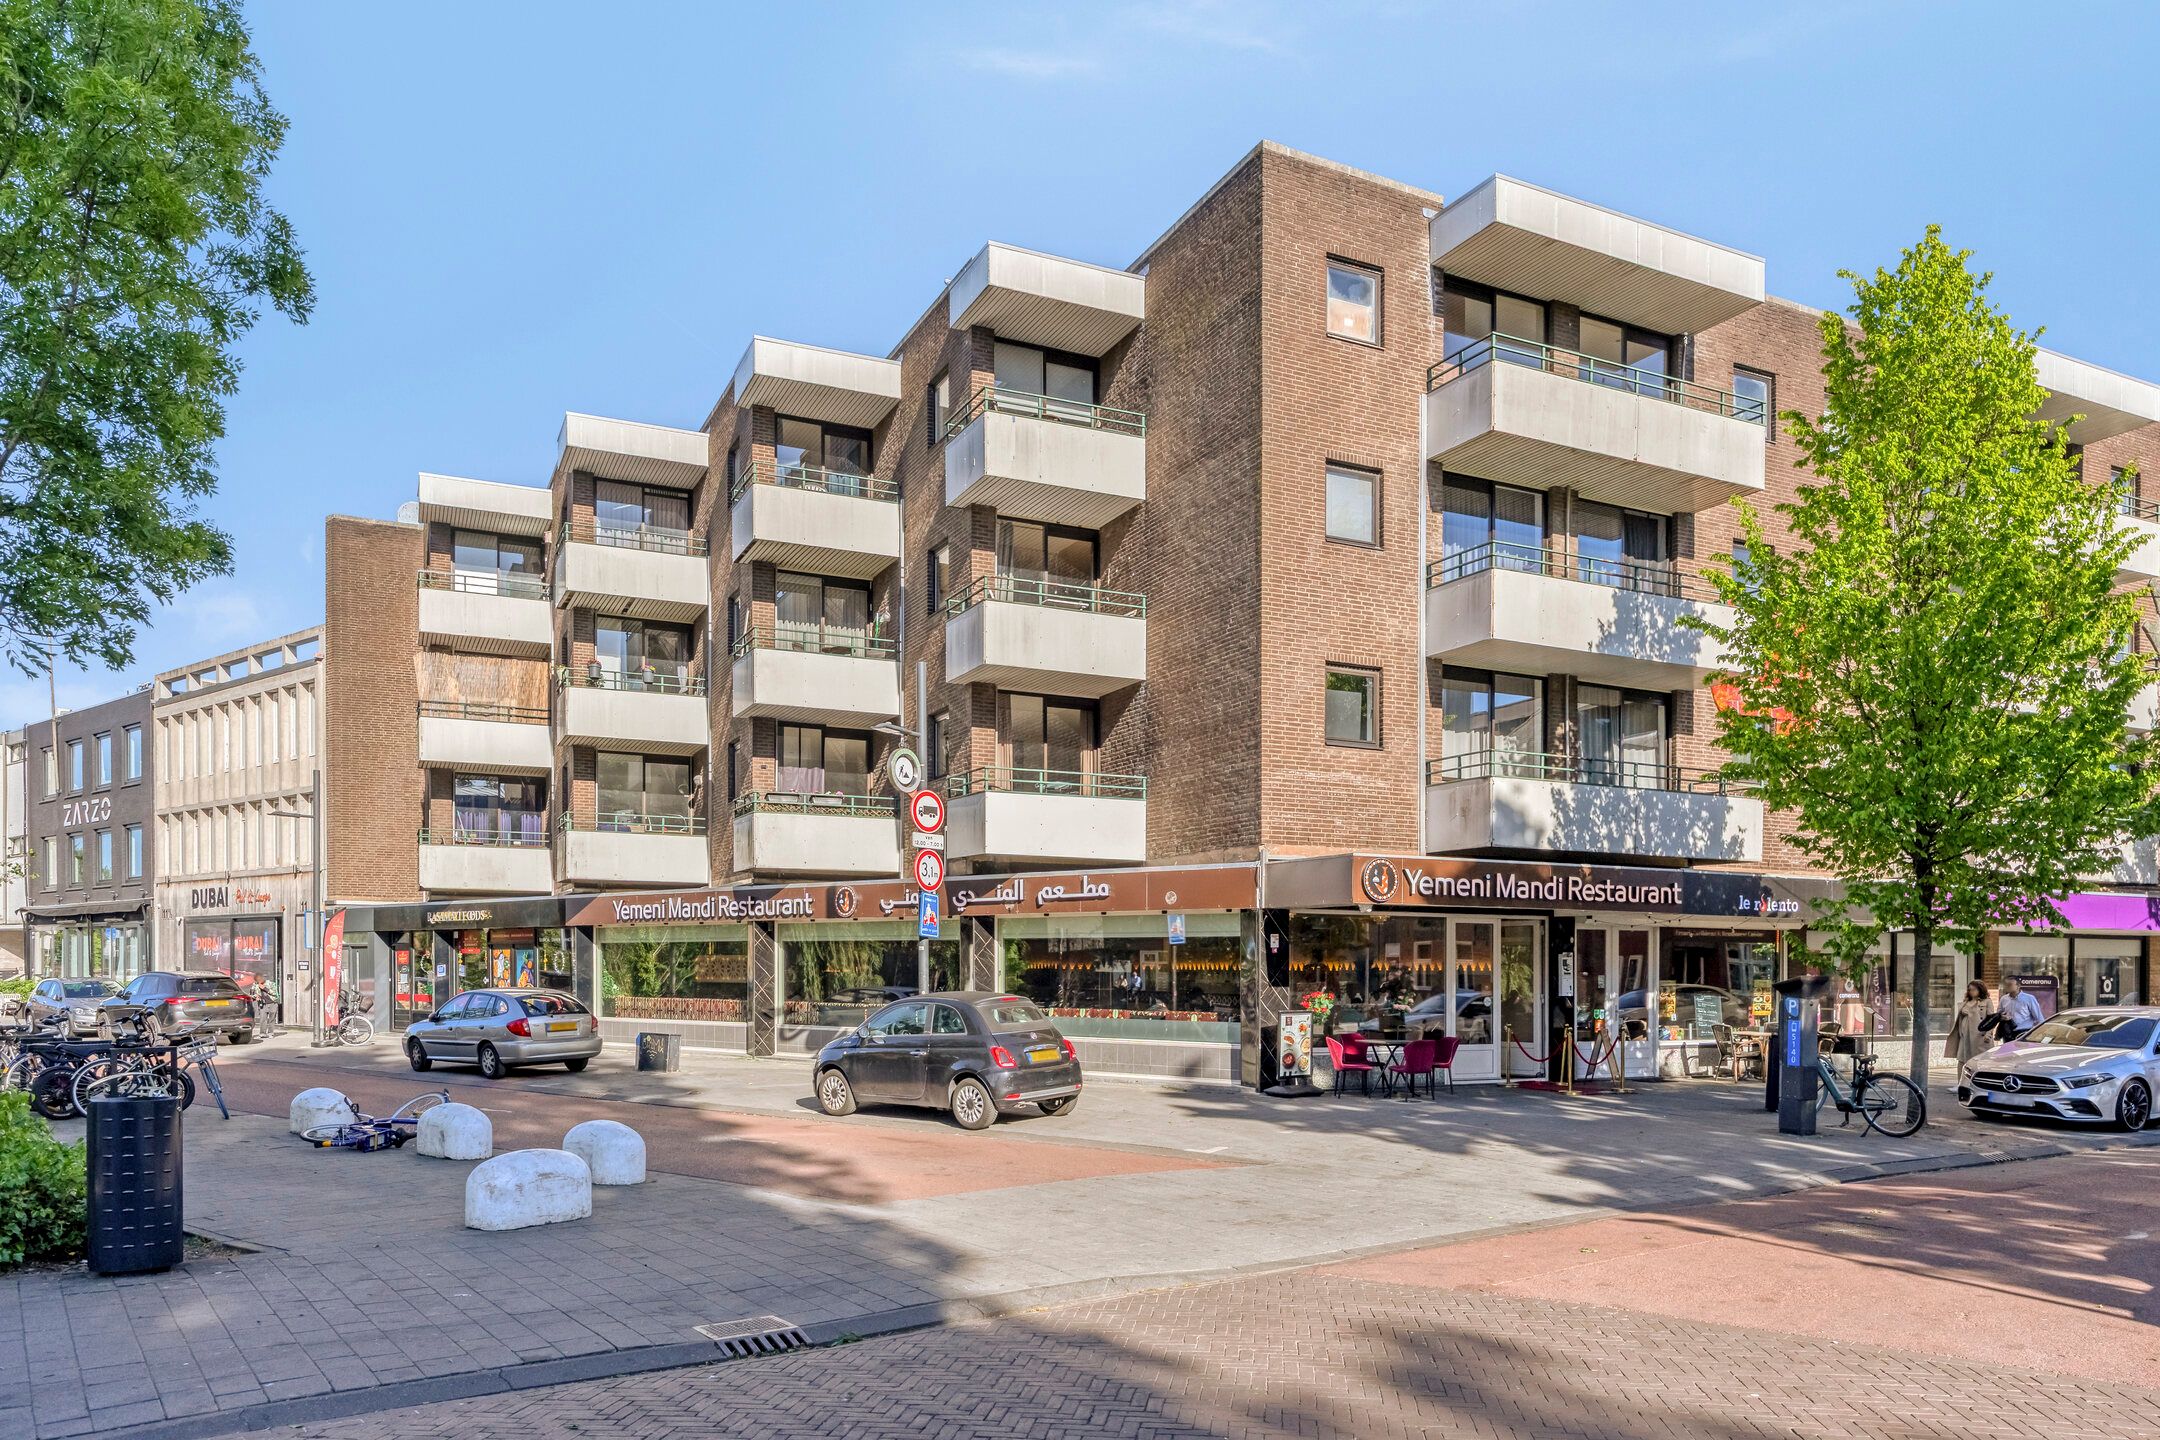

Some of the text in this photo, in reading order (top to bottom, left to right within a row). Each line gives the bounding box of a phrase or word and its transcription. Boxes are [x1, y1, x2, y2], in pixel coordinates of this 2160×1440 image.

[63, 797, 111, 827] ZARZO
[192, 887, 229, 909] DUBAI
[1039, 875, 1109, 905] مطعم
[1402, 868, 1682, 905] Yemeni Mandi Restaurant
[612, 893, 813, 921] Yemeni Mandi Restaurant
[1738, 895, 1751, 910] le
[1788, 999, 1797, 1014] P
